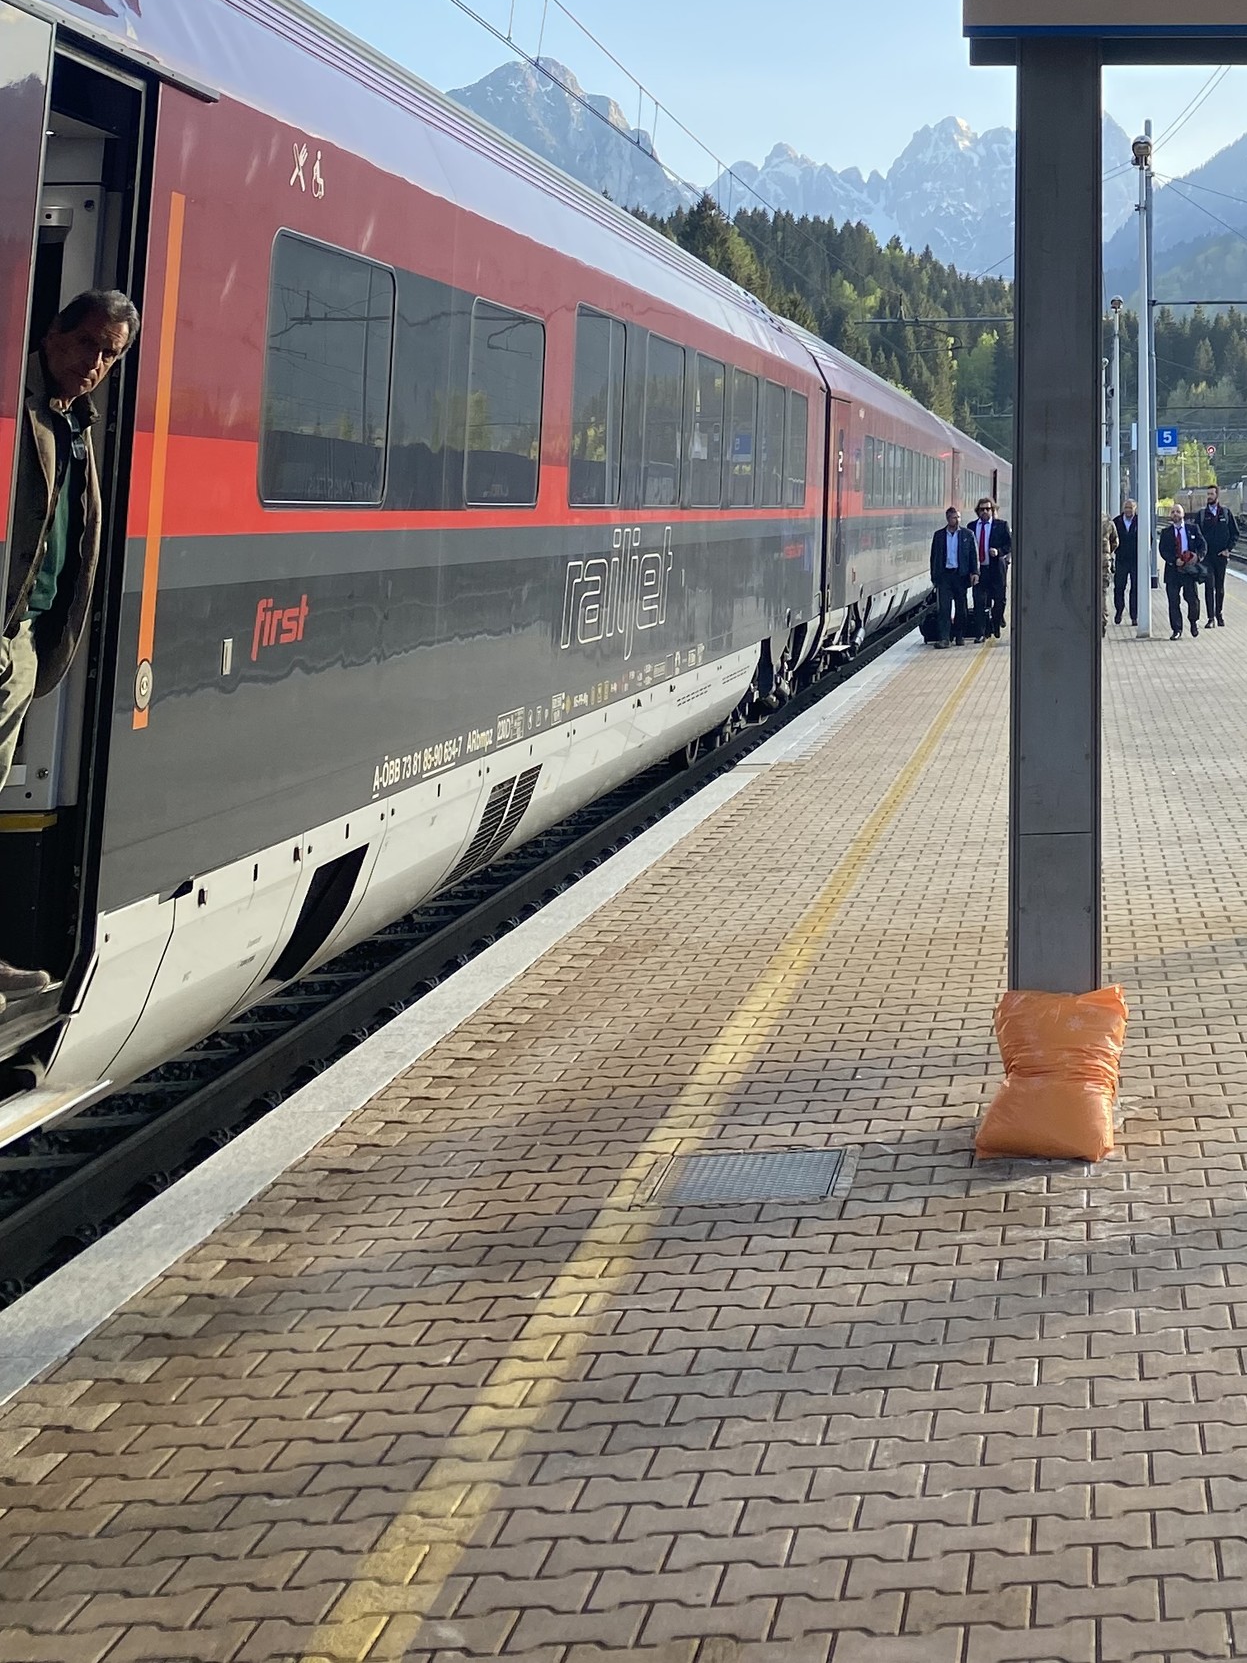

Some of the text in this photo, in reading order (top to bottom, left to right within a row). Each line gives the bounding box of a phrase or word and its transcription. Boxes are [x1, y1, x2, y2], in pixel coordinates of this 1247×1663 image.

[1163, 431, 1172, 444] 5
[560, 525, 673, 661] railjet
[251, 593, 309, 662] first
[402, 754, 412, 779] 73
[412, 751, 422, 776] 81
[444, 736, 463, 763] 654-7
